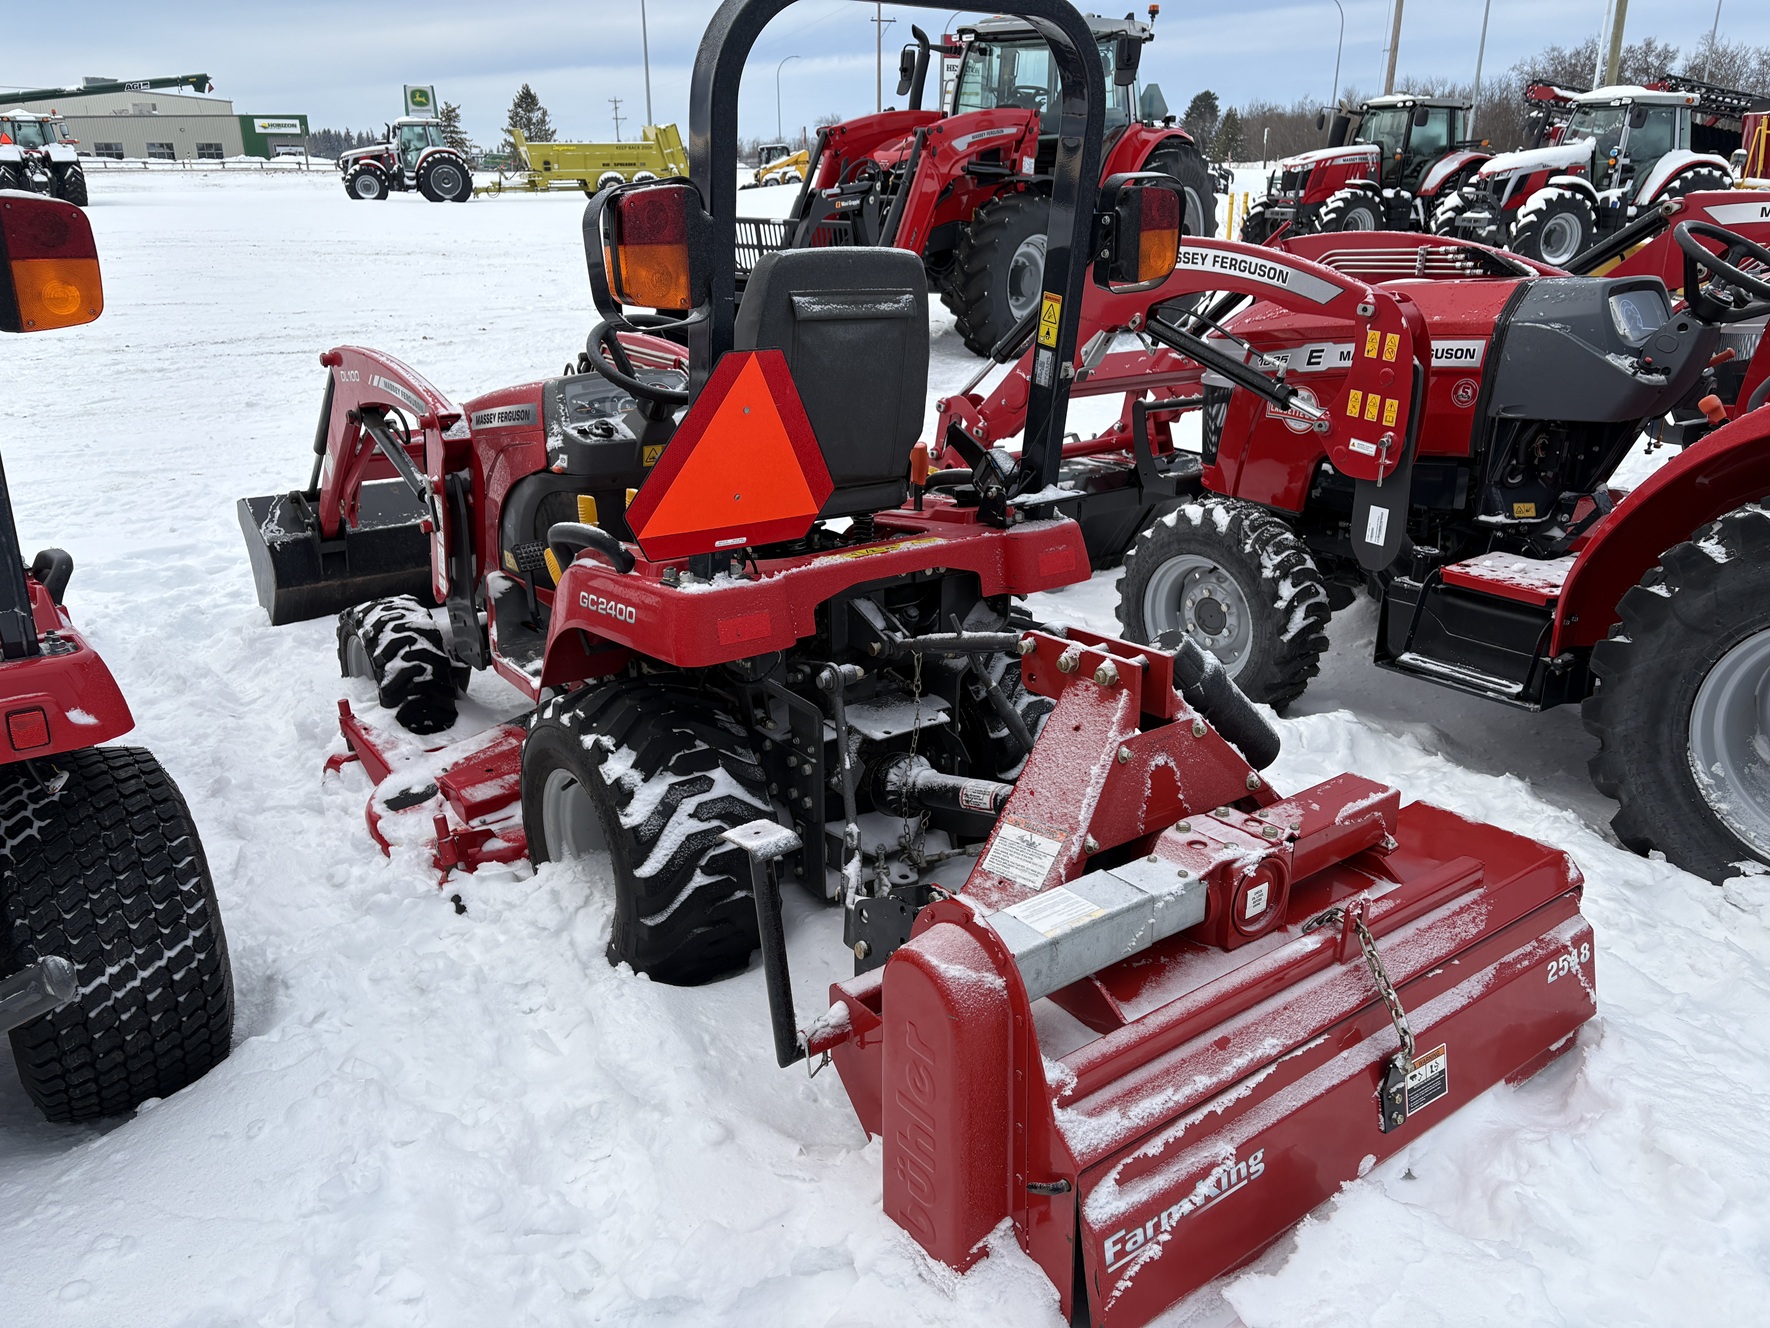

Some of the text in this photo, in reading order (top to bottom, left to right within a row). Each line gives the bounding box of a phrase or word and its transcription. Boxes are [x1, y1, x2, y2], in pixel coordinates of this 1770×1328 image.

[126, 83, 142, 91] AGI
[1212, 254, 1289, 284] FERGUSON
[475, 409, 531, 426] MASSEY FERGUSON
[579, 591, 636, 624] GC2400
